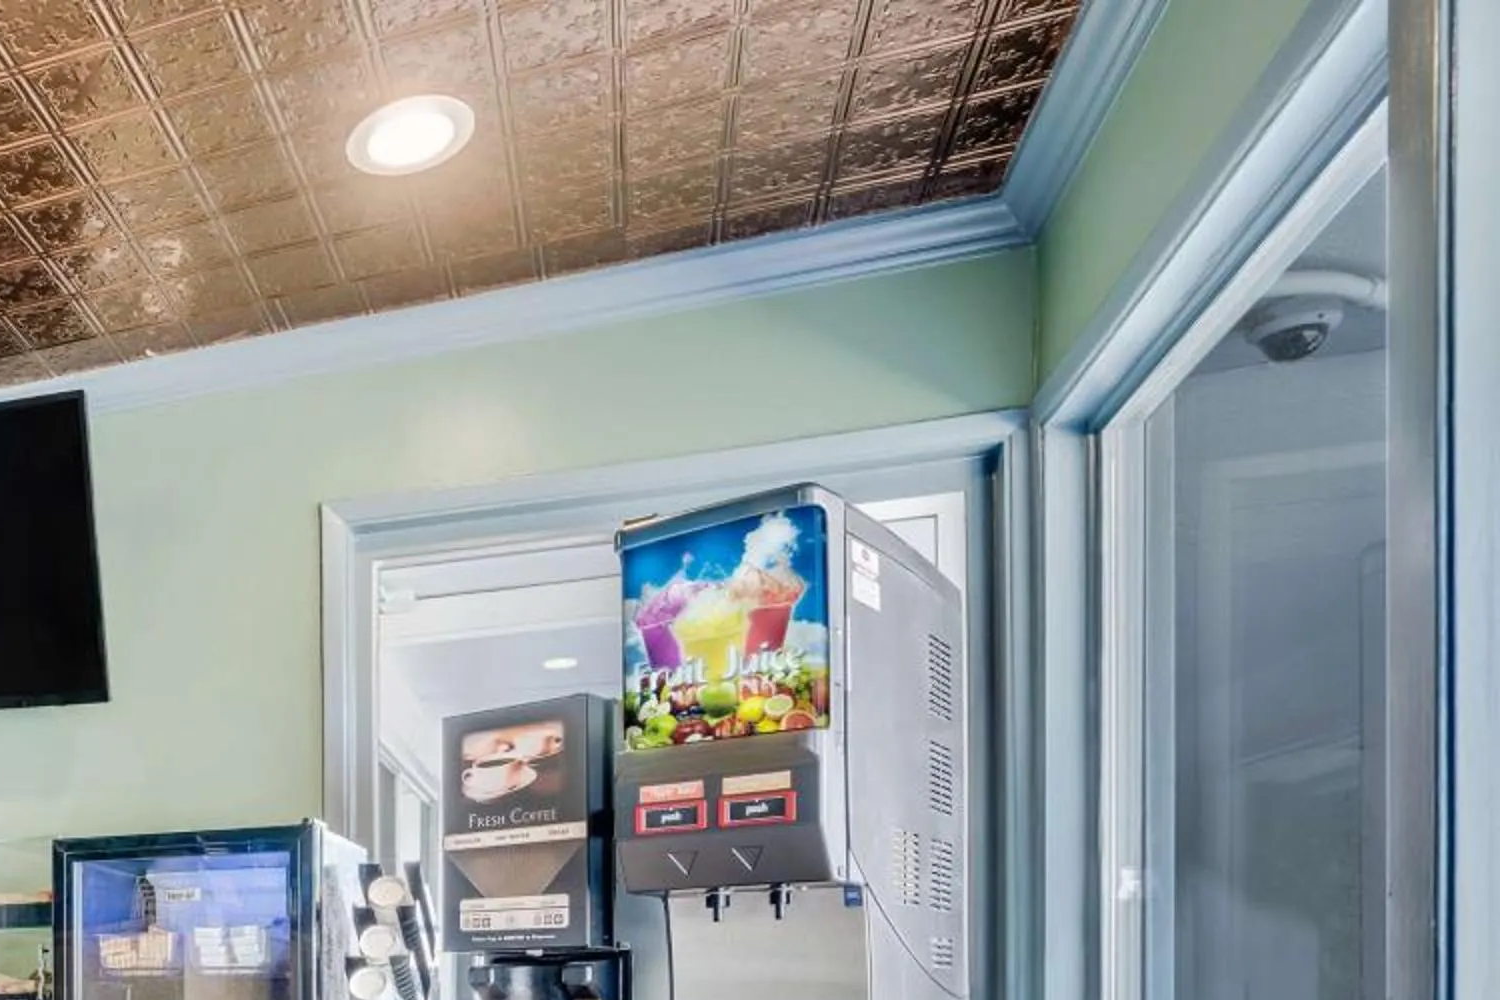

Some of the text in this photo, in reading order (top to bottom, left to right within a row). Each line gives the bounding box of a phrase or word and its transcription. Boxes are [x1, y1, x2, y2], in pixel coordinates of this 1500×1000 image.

[634, 643, 805, 692] Fruit Juice
[468, 807, 557, 829] FRESH COFFEE
